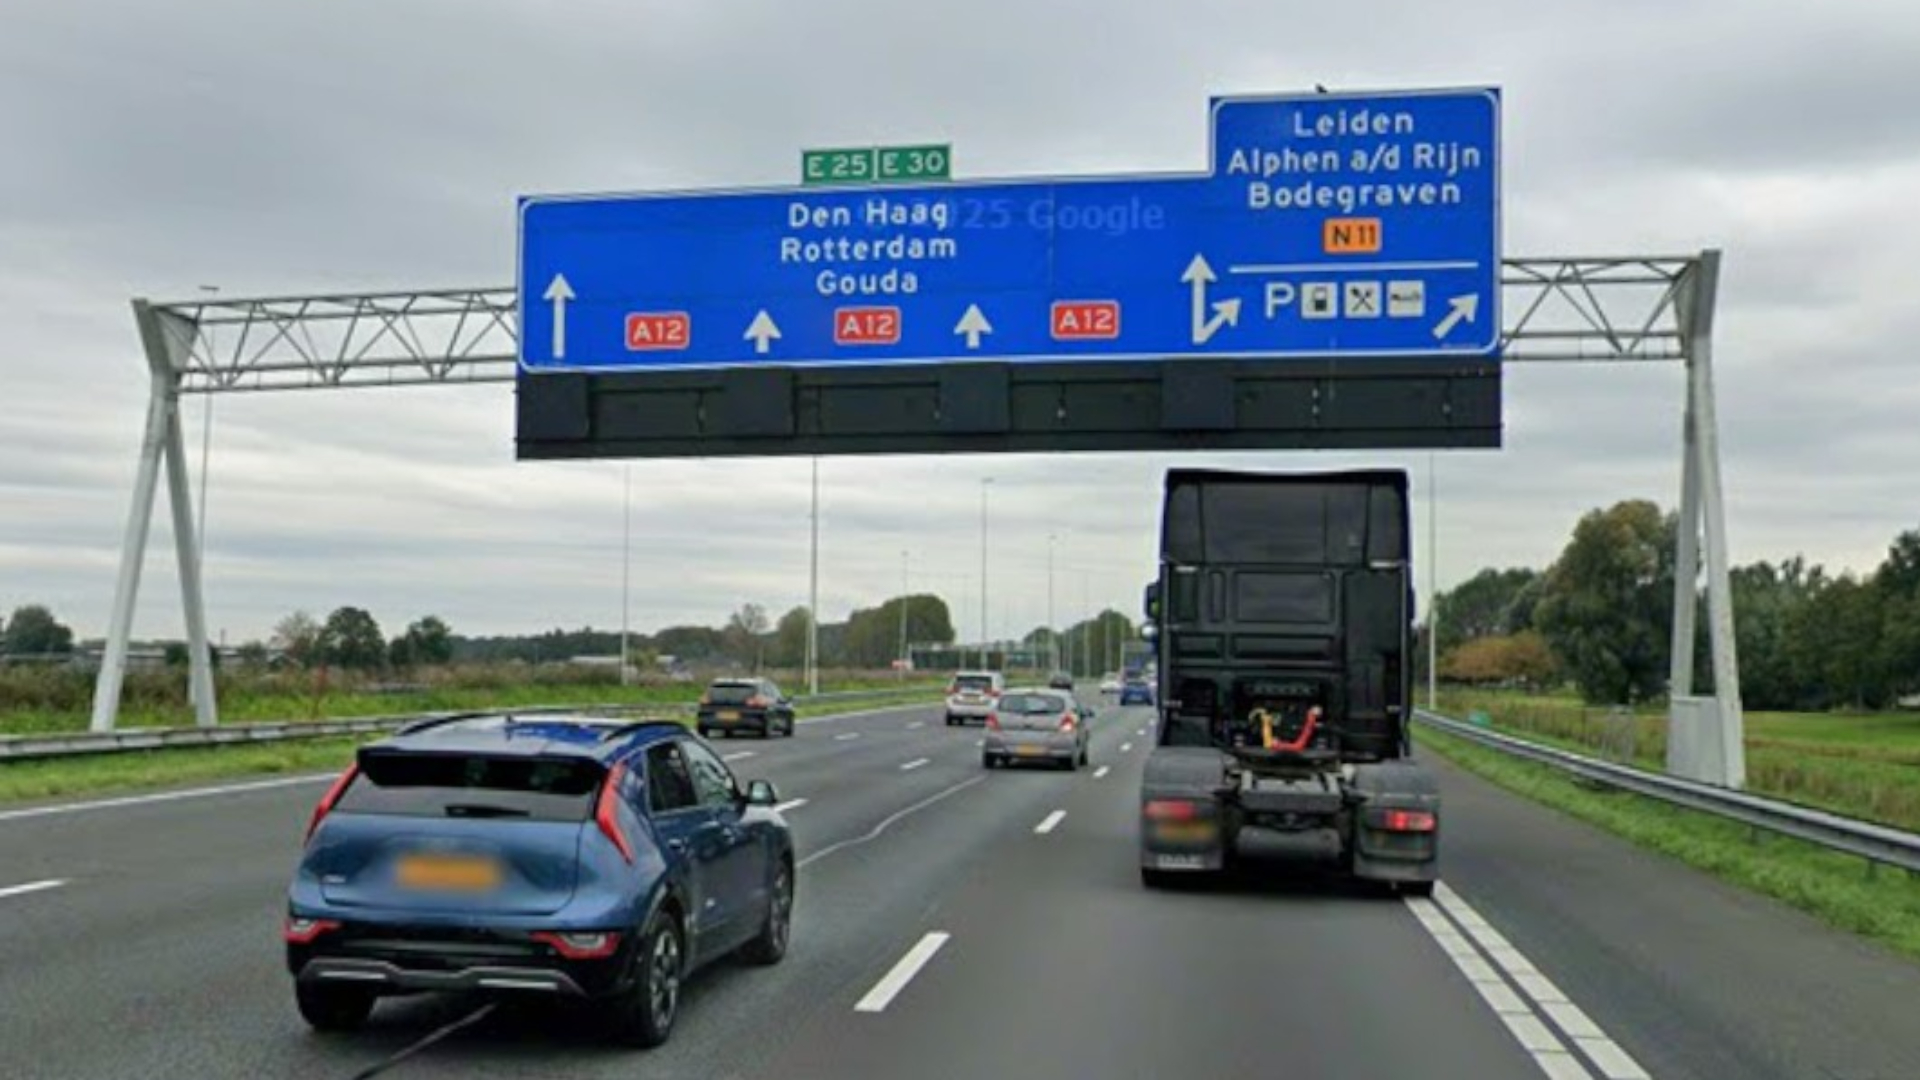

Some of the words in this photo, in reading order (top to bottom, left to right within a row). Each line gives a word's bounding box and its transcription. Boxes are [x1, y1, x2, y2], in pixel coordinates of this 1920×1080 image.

[1294, 110, 1414, 137] Leiden
[807, 156, 824, 177] E
[831, 154, 868, 177] 25
[882, 153, 899, 174] E
[906, 151, 945, 174] 30
[1227, 148, 1339, 178] Alphen
[1350, 143, 1400, 172] a/d
[1413, 142, 1481, 176] Rijn
[1249, 181, 1461, 213] Bodegraven
[789, 202, 850, 227] Den
[866, 199, 948, 230] Haag
[1332, 226, 1351, 246] N
[1357, 225, 1376, 245] 11
[781, 234, 957, 262] Rotterdam
[816, 268, 918, 294] Gouda
[633, 320, 683, 342] A12
[841, 314, 894, 336] A12
[1058, 309, 1113, 331] A12
